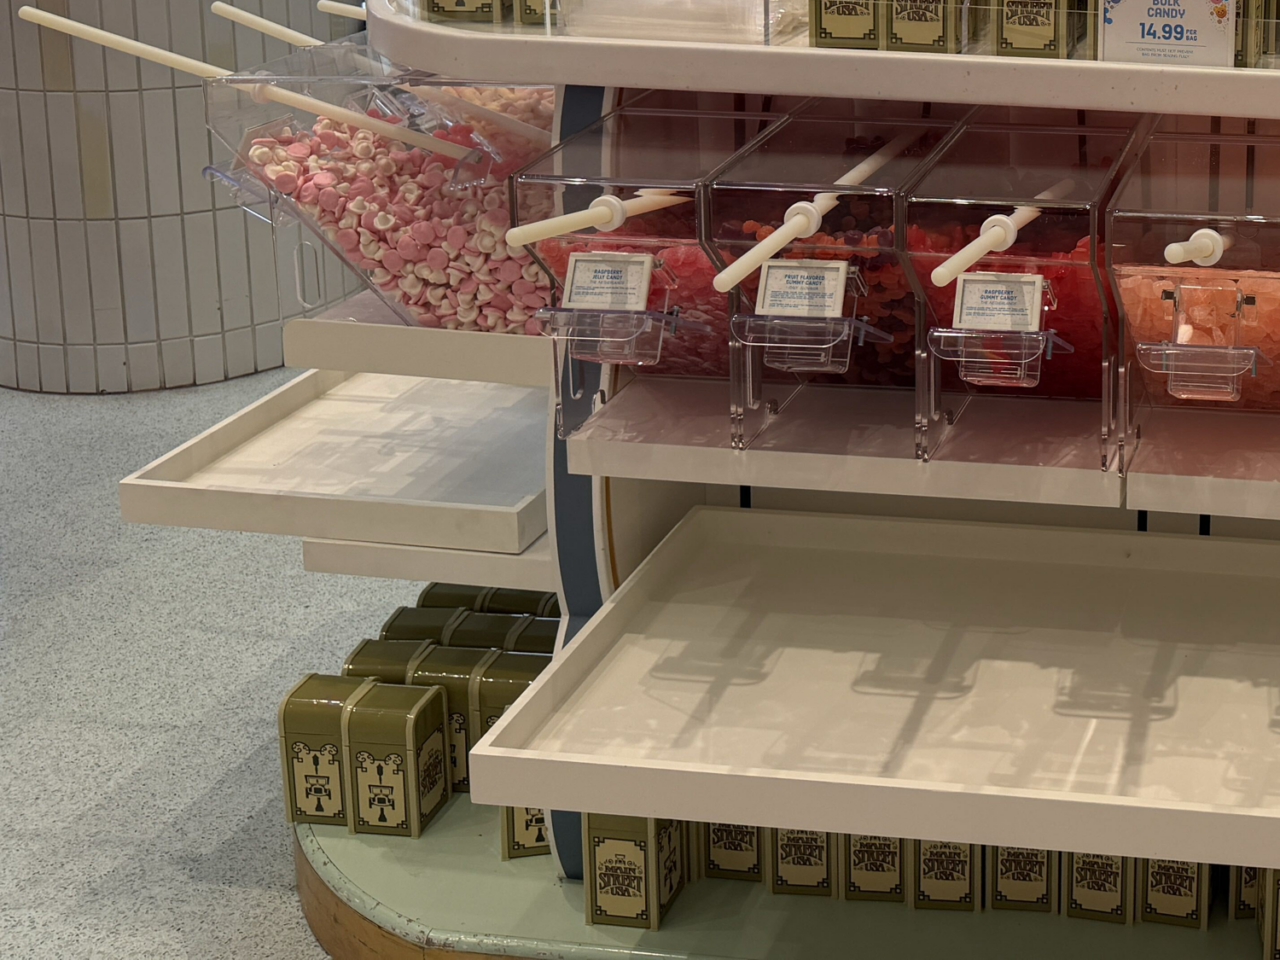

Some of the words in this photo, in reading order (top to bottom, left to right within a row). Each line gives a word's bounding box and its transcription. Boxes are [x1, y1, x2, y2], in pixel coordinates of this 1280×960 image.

[836, 4, 859, 16] USA
[1006, 1, 1053, 22] STREET
[1147, 7, 1185, 19] CANDY
[906, 10, 929, 22] USA
[1018, 15, 1040, 27] USA
[1139, 23, 1184, 41] 14.99
[786, 836, 817, 844] MAIN
[723, 841, 744, 852] USA
[859, 842, 890, 850] MAIN
[780, 844, 824, 862] STREET
[929, 850, 962, 859] MAIN
[1006, 851, 1039, 860] MAIN
[792, 856, 813, 866] USA
[852, 850, 897, 869] STREET
[1081, 860, 1114, 870] MAIN
[604, 865, 636, 875] MAIN
[865, 862, 885, 872] USA
[922, 858, 968, 877] STREET
[1000, 859, 1045, 878] STREET
[1156, 865, 1190, 874] MAIN
[936, 871, 956, 881] USA
[1012, 872, 1034, 882] USA
[1074, 868, 1120, 888] STREET
[599, 873, 643, 894] STREET
[1086, 882, 1108, 892] USA
[1150, 874, 1195, 894] STREET
[610, 886, 632, 898] USA
[1162, 886, 1184, 897] USA
